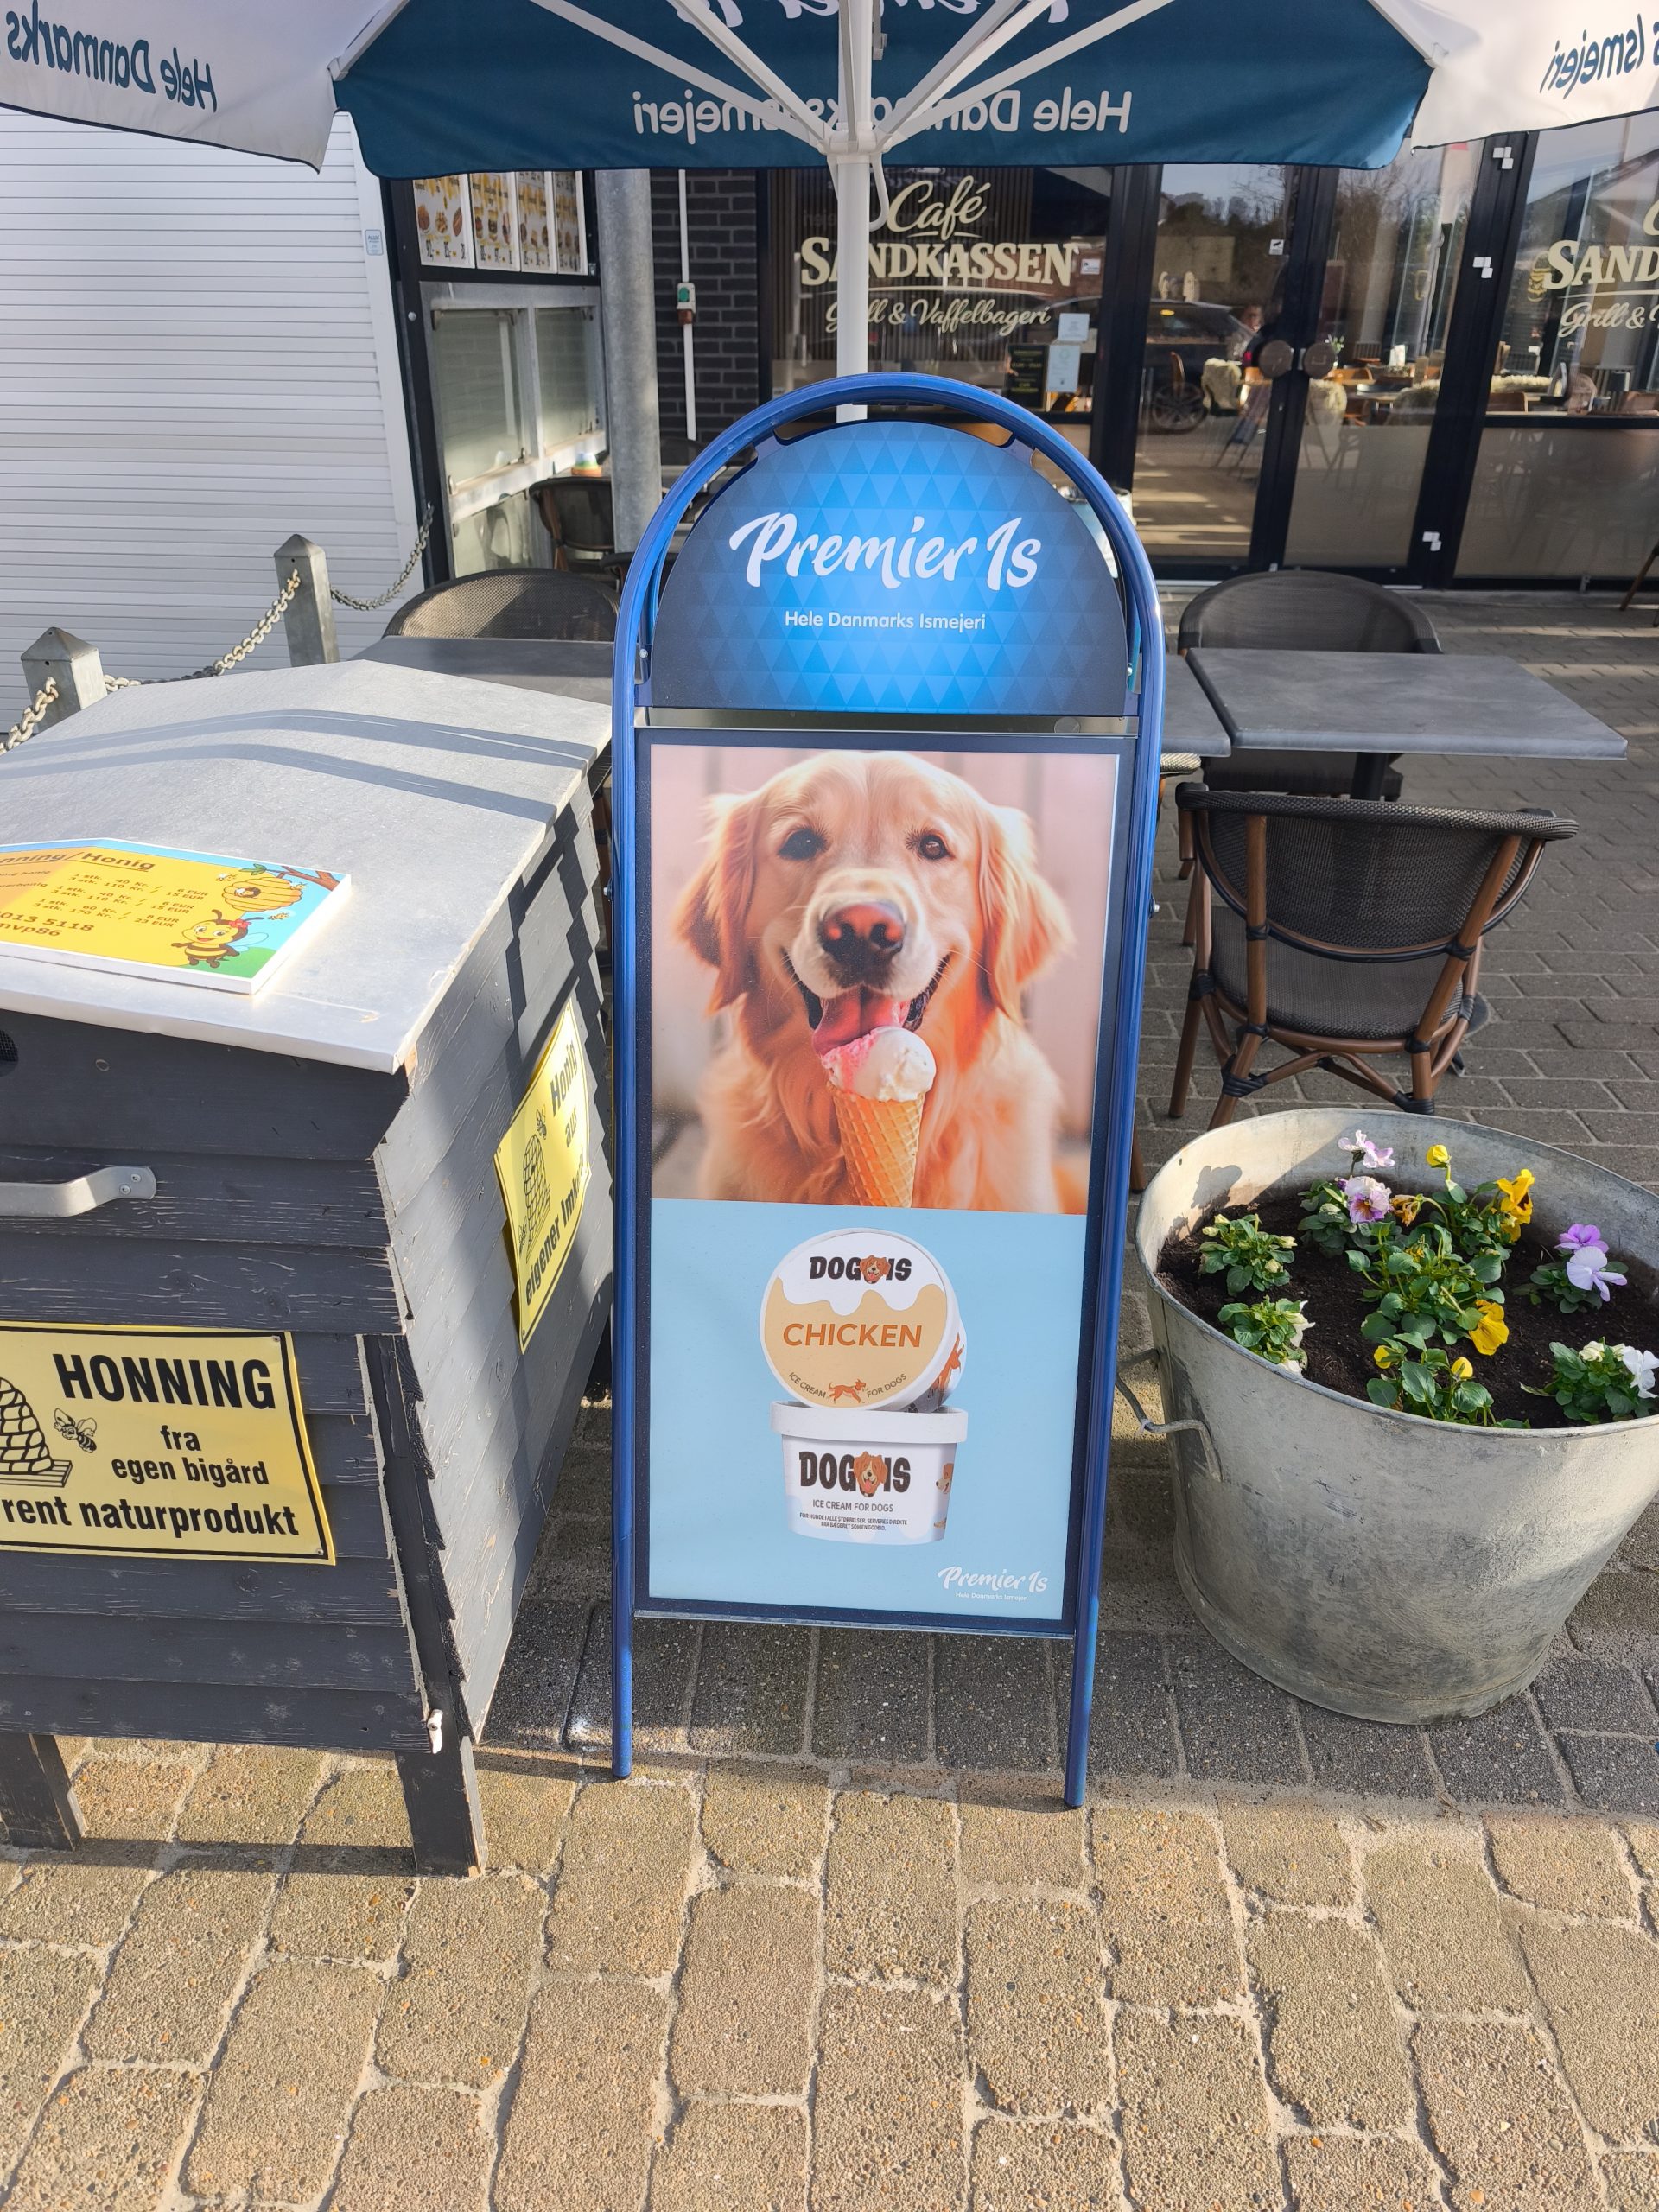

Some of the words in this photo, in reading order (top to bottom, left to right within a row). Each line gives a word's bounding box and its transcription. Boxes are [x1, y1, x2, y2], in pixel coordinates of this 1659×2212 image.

[887, 175, 991, 241] Café
[801, 237, 1077, 286] SNDKASSEN
[888, 302, 906, 325] &
[910, 299, 1051, 336] Vaffelbageri
[1558, 302, 1630, 337] Grill
[1625, 306, 1645, 329] &
[728, 512, 977, 589] Premier
[986, 517, 1042, 590] Is
[785, 611, 823, 627] Hele
[829, 612, 914, 628] Danmarks
[919, 613, 985, 633] Ismejeri
[42, 918, 94, 931] 5118
[550, 1040, 578, 1117] Honig
[526, 1214, 562, 1306] eigener
[783, 1323, 922, 1348] CHICKEN
[52, 1353, 276, 1409] HONNING
[789, 1372, 801, 1384] ICE
[799, 1380, 827, 1398] CREAM
[866, 1385, 883, 1398] FOR
[884, 1373, 907, 1392] DOGS
[160, 1425, 201, 1452] fra
[111, 1459, 176, 1484] egen
[182, 1457, 270, 1488] bigård
[1, 1496, 72, 1526] rent
[79, 1498, 299, 1538] naturprodukt
[812, 1499, 824, 1508] ICE
[826, 1501, 852, 1510] CREAM
[854, 1503, 870, 1511] FOR
[872, 1503, 893, 1512] DOGS
[937, 1566, 1026, 1591] Premier
[1028, 1570, 1048, 1592] Is
